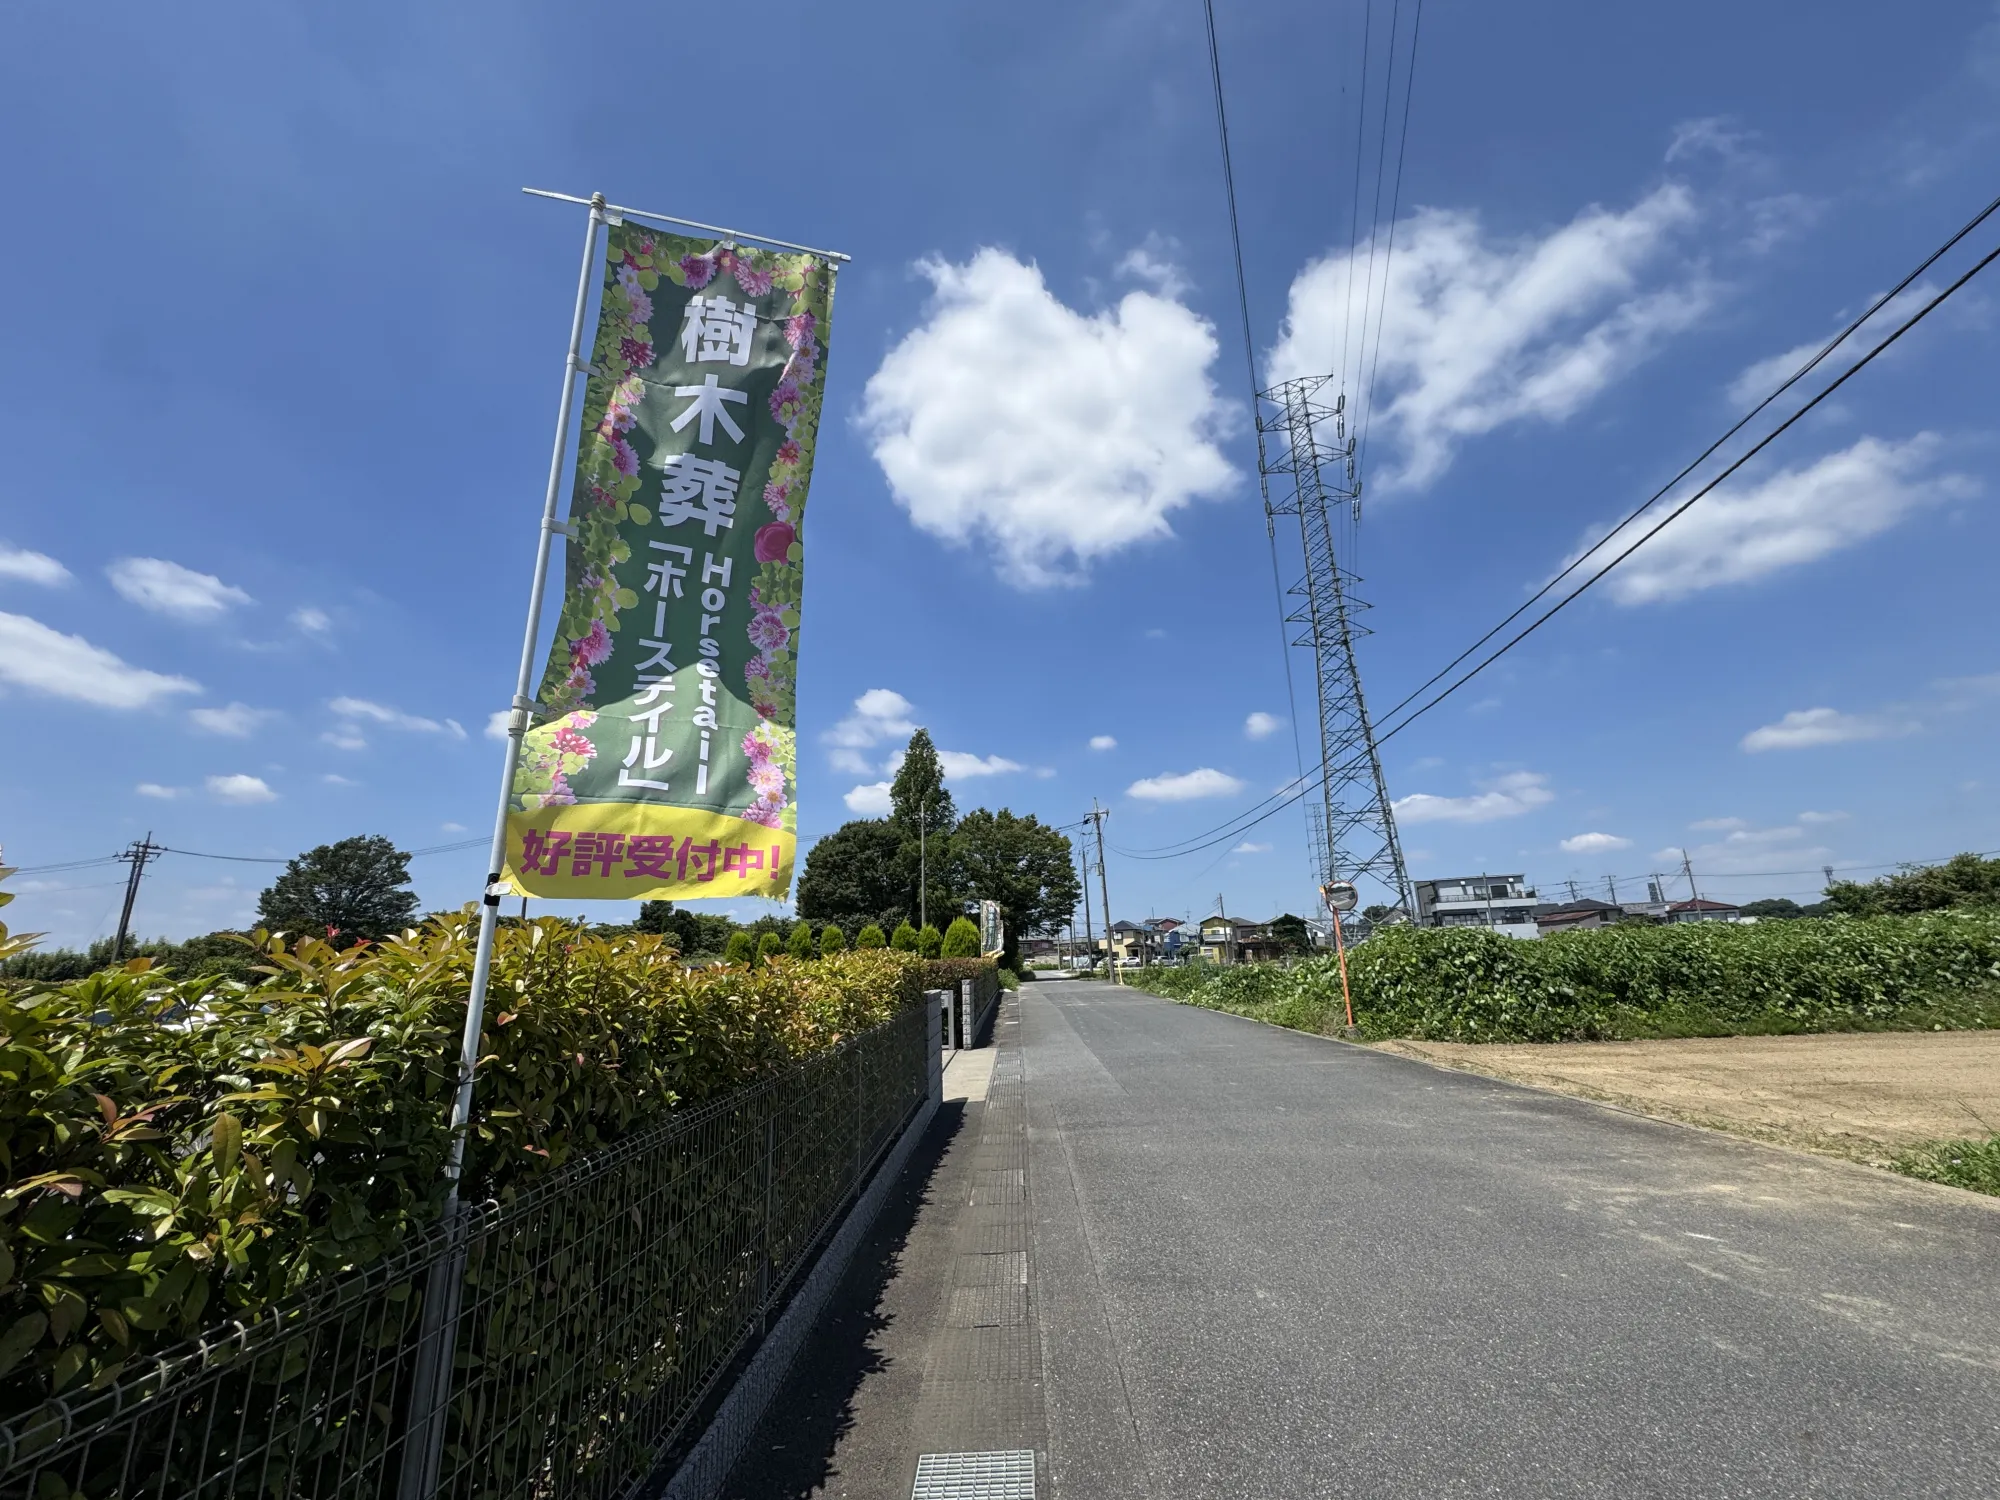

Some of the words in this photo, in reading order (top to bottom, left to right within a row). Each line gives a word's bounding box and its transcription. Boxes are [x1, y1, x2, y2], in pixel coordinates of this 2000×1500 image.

[658, 295, 758, 537] 樹木葬
[618, 540, 693, 791] 「ホーステイル」
[692, 551, 733, 795] Horsetail
[519, 828, 781, 882] 好評受付中!
